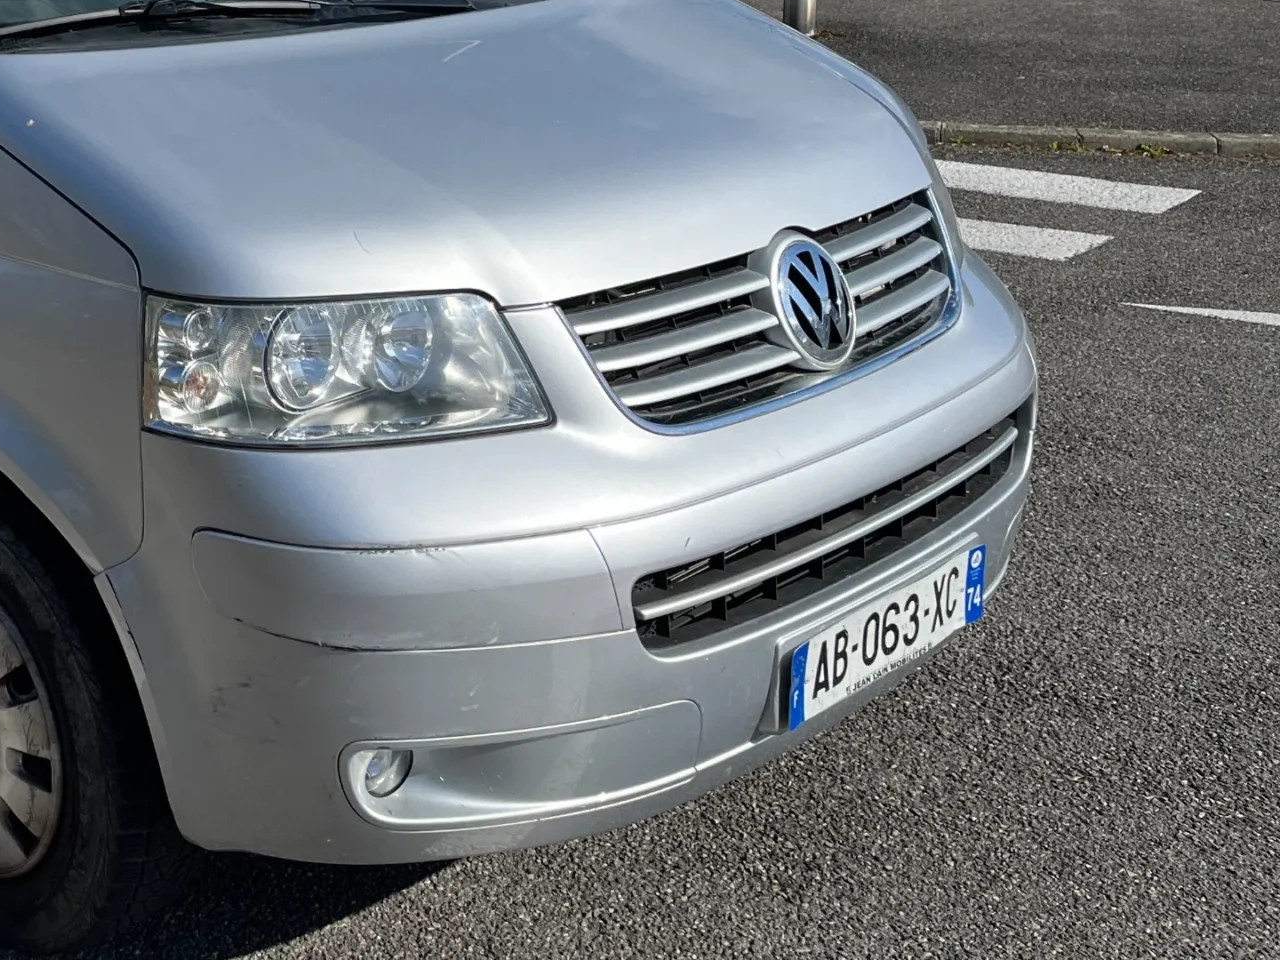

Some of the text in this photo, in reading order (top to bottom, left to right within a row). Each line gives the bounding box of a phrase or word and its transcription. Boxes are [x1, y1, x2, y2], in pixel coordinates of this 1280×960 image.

[967, 584, 981, 611] 74
[812, 566, 959, 700] AB-063-XC
[852, 675, 872, 692] JEAN
[793, 690, 799, 708] F
